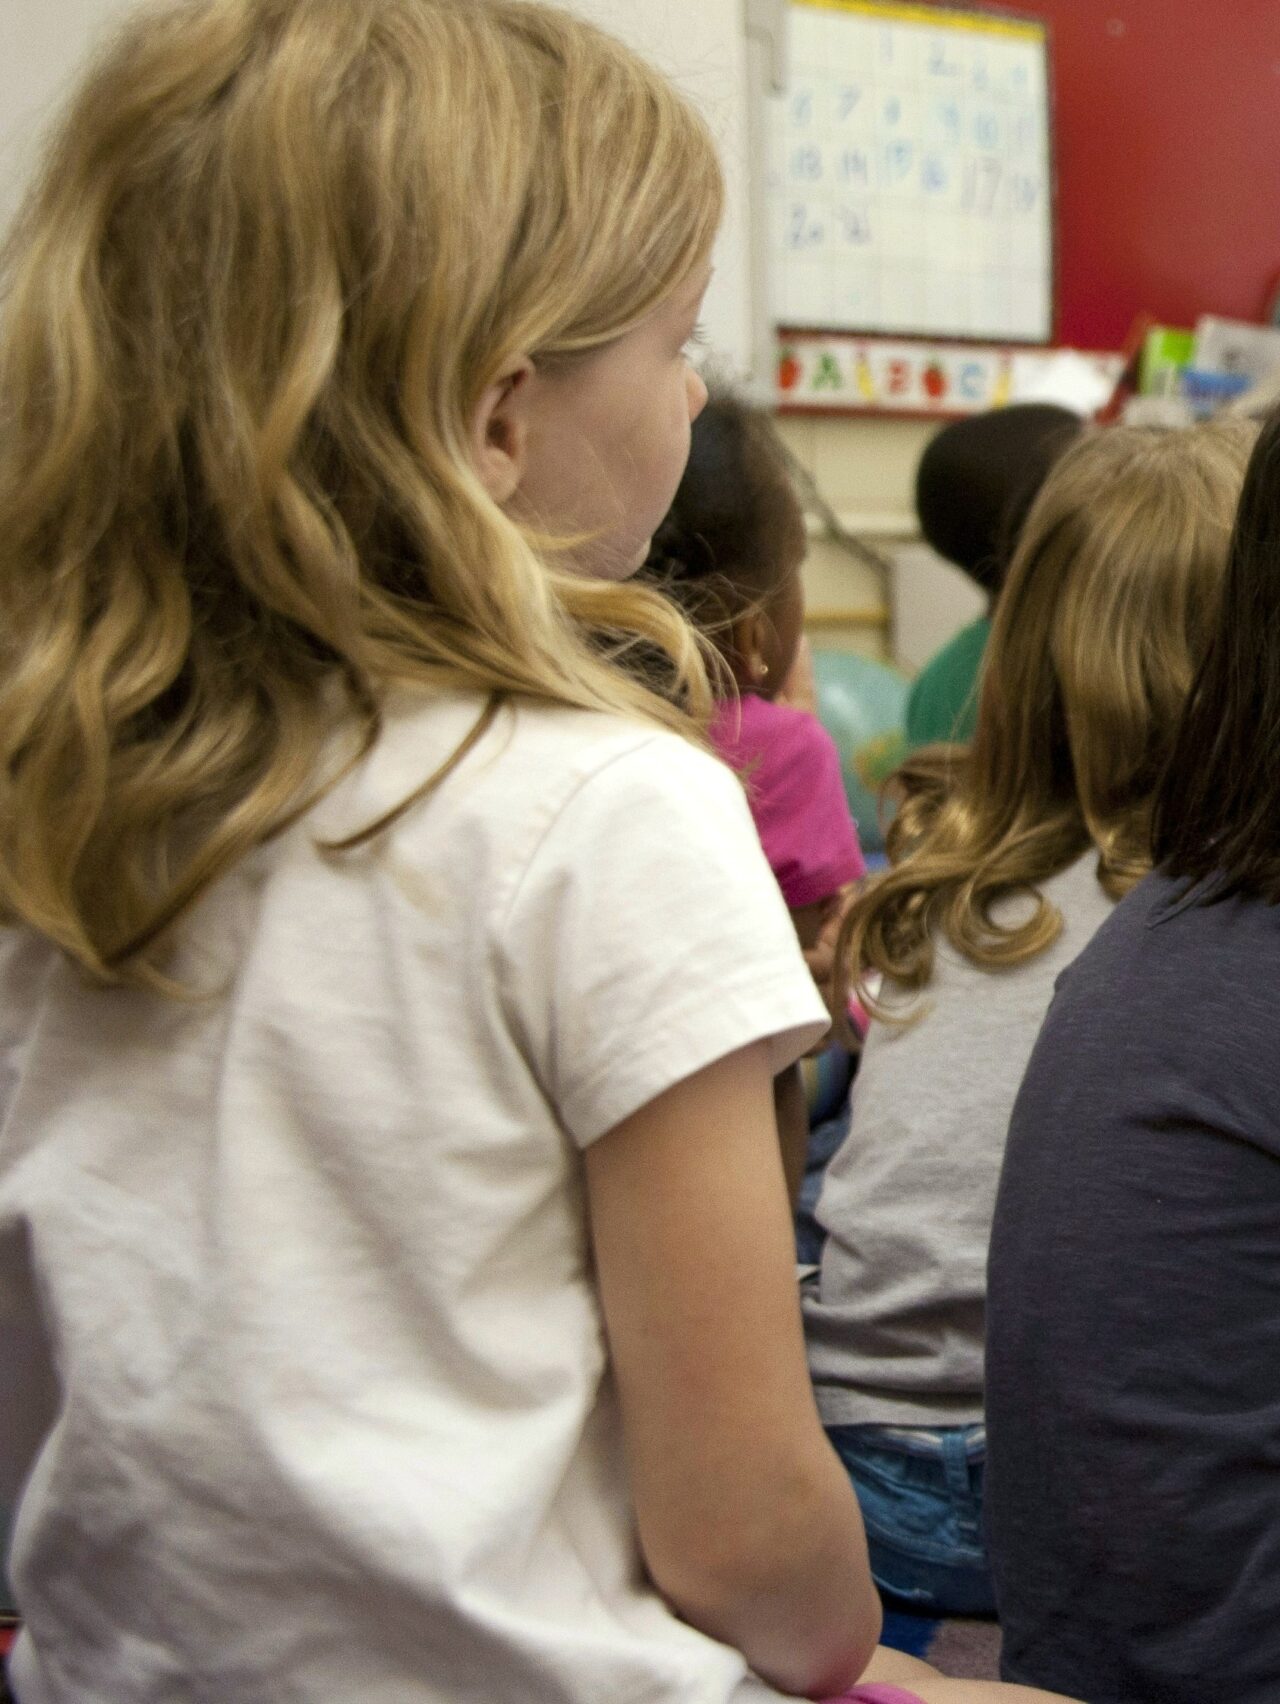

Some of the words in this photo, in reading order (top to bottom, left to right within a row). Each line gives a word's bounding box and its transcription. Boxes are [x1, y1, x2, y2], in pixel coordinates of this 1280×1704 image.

[811, 352, 842, 391] A
[886, 358, 910, 396] B
[959, 363, 983, 399] C
